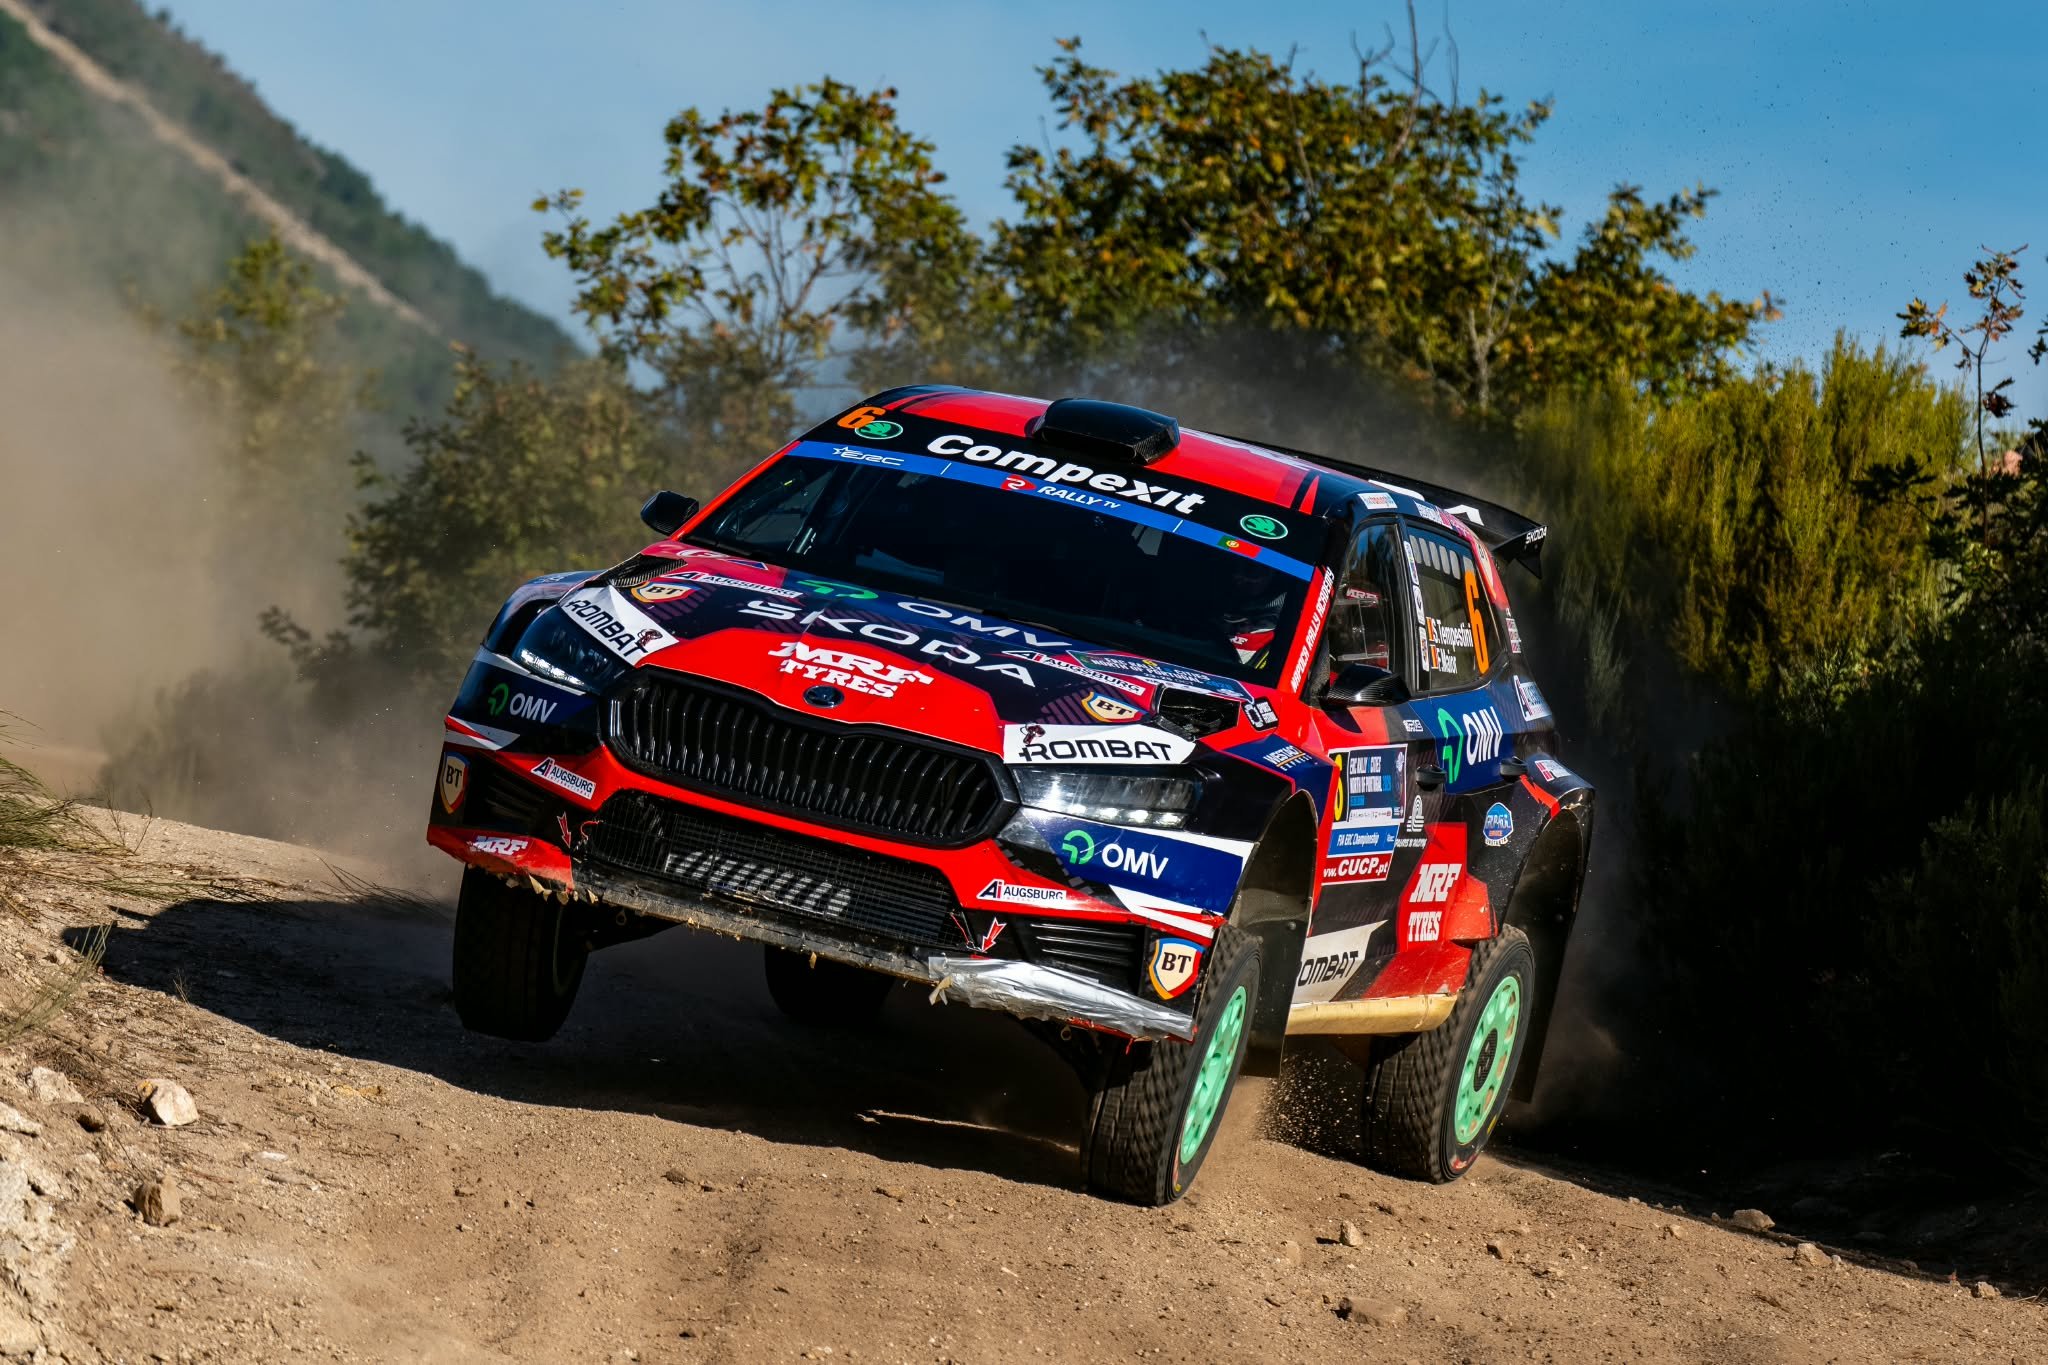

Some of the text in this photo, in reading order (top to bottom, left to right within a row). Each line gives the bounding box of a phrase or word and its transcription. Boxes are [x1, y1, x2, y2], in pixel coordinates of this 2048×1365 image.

[836, 406, 886, 429] 6
[927, 434, 1206, 515] Compexit
[1037, 485, 1121, 509] RALLY TV
[648, 584, 684, 597] BT
[704, 574, 799, 598] AUGSBURG
[564, 600, 650, 658] ROMBAT
[897, 601, 1073, 649] OMV
[1305, 611, 1321, 651] RALLY
[1464, 570, 1490, 674] 6
[768, 640, 934, 686] MRF
[779, 659, 898, 698] TYRES
[1045, 656, 1142, 693] AUGSBURG
[509, 692, 558, 724] OMV
[1094, 699, 1133, 716] BT
[1018, 740, 1172, 762] ROMBAT
[1462, 705, 1504, 766] OMV
[445, 764, 463, 787] BT
[550, 766, 593, 794] AUGSBURG
[472, 835, 530, 856] MRF
[1101, 843, 1169, 880] OMV
[1003, 886, 1063, 900] AUGSBURG
[1409, 863, 1462, 903] MRF
[1408, 910, 1442, 943] TYRES
[1160, 951, 1192, 975] BT
[1298, 950, 1359, 987] OMBAT
